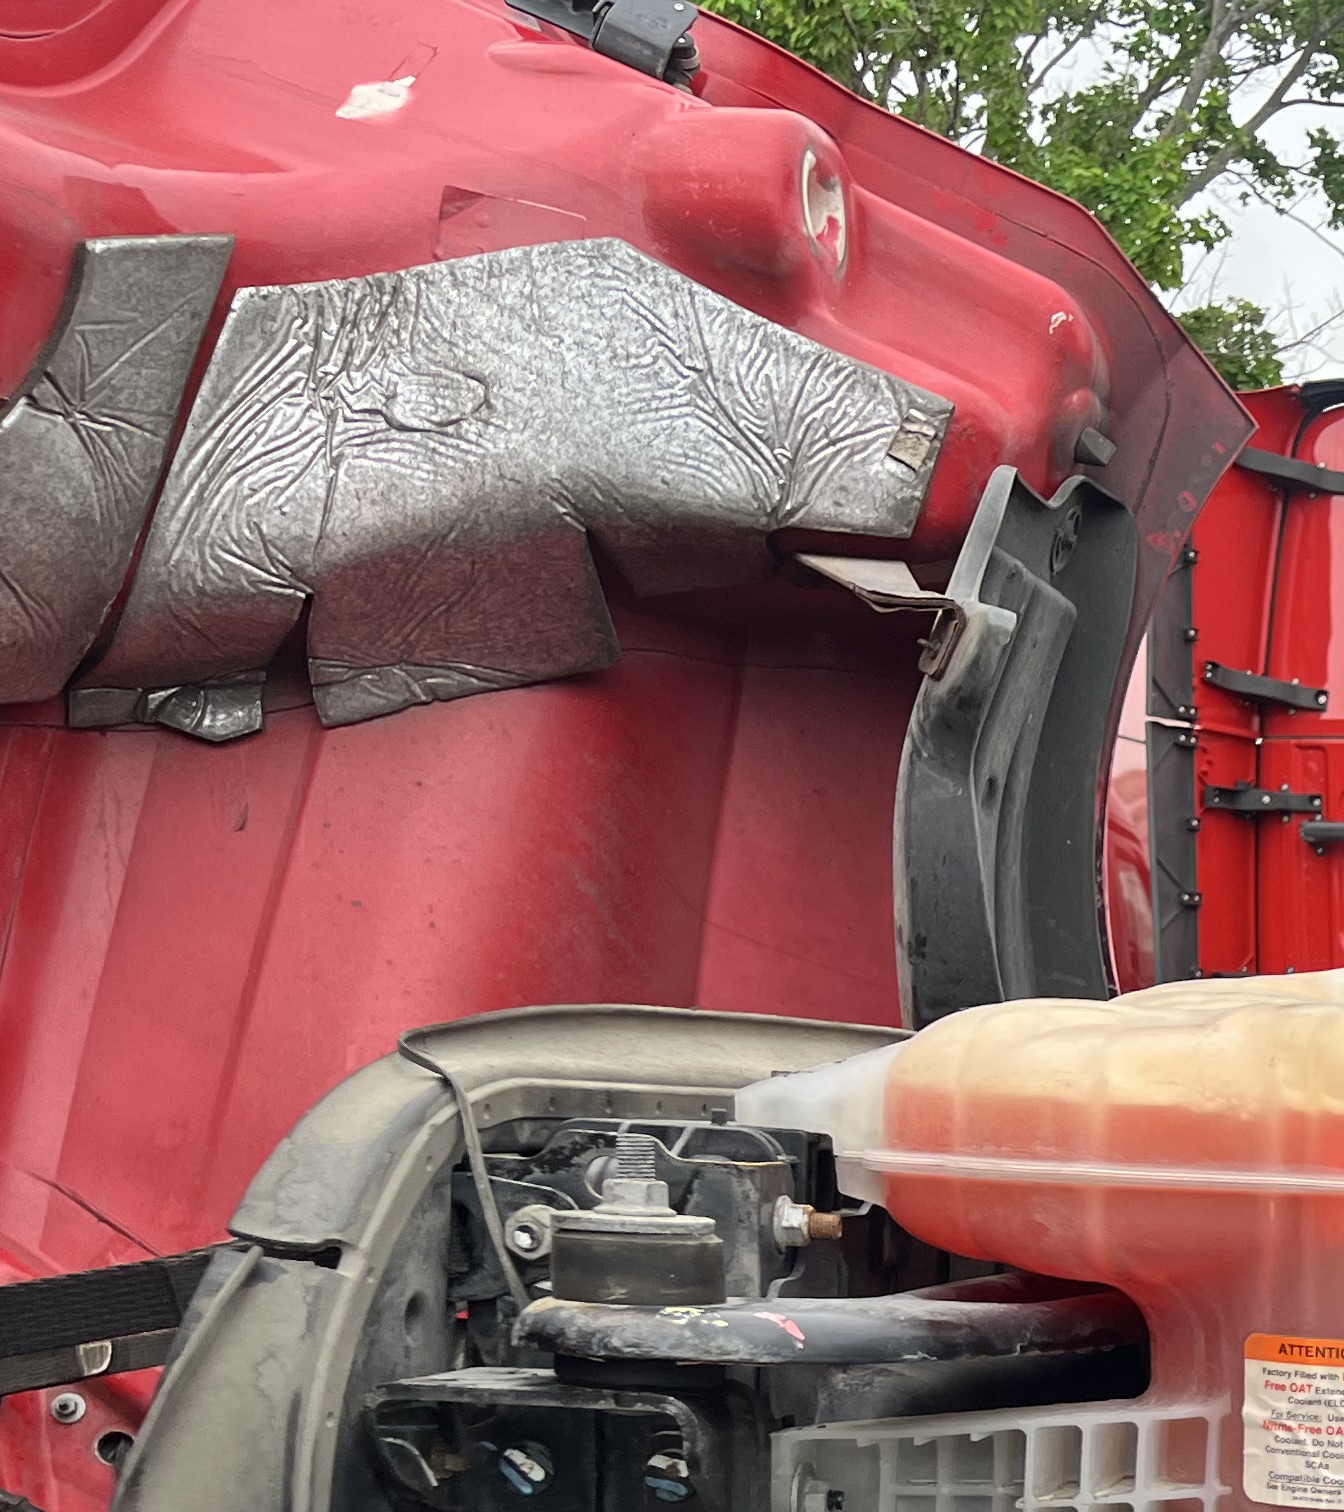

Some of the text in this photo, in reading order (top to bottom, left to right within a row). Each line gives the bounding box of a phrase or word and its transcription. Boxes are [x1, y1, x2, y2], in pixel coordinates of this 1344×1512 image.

[1262, 1367, 1292, 1379] Factory
[1294, 1370, 1317, 1380] Filled
[1320, 1372, 1340, 1381] with
[1264, 1380, 1287, 1392] Free
[1289, 1382, 1313, 1393] OAT
[1287, 1396, 1322, 1406] Coolant
[1270, 1409, 1284, 1419] For
[1327, 1414, 1344, 1423] Use
[1312, 1439, 1324, 1448] Do
[1327, 1440, 1343, 1448] Not
[1265, 1445, 1320, 1458] Conventional
[1304, 1460, 1330, 1470] SCAs
[1268, 1471, 1320, 1484] Compatible
[1281, 1484, 1308, 1495] Engine
[1311, 1486, 1342, 1495] Owners
